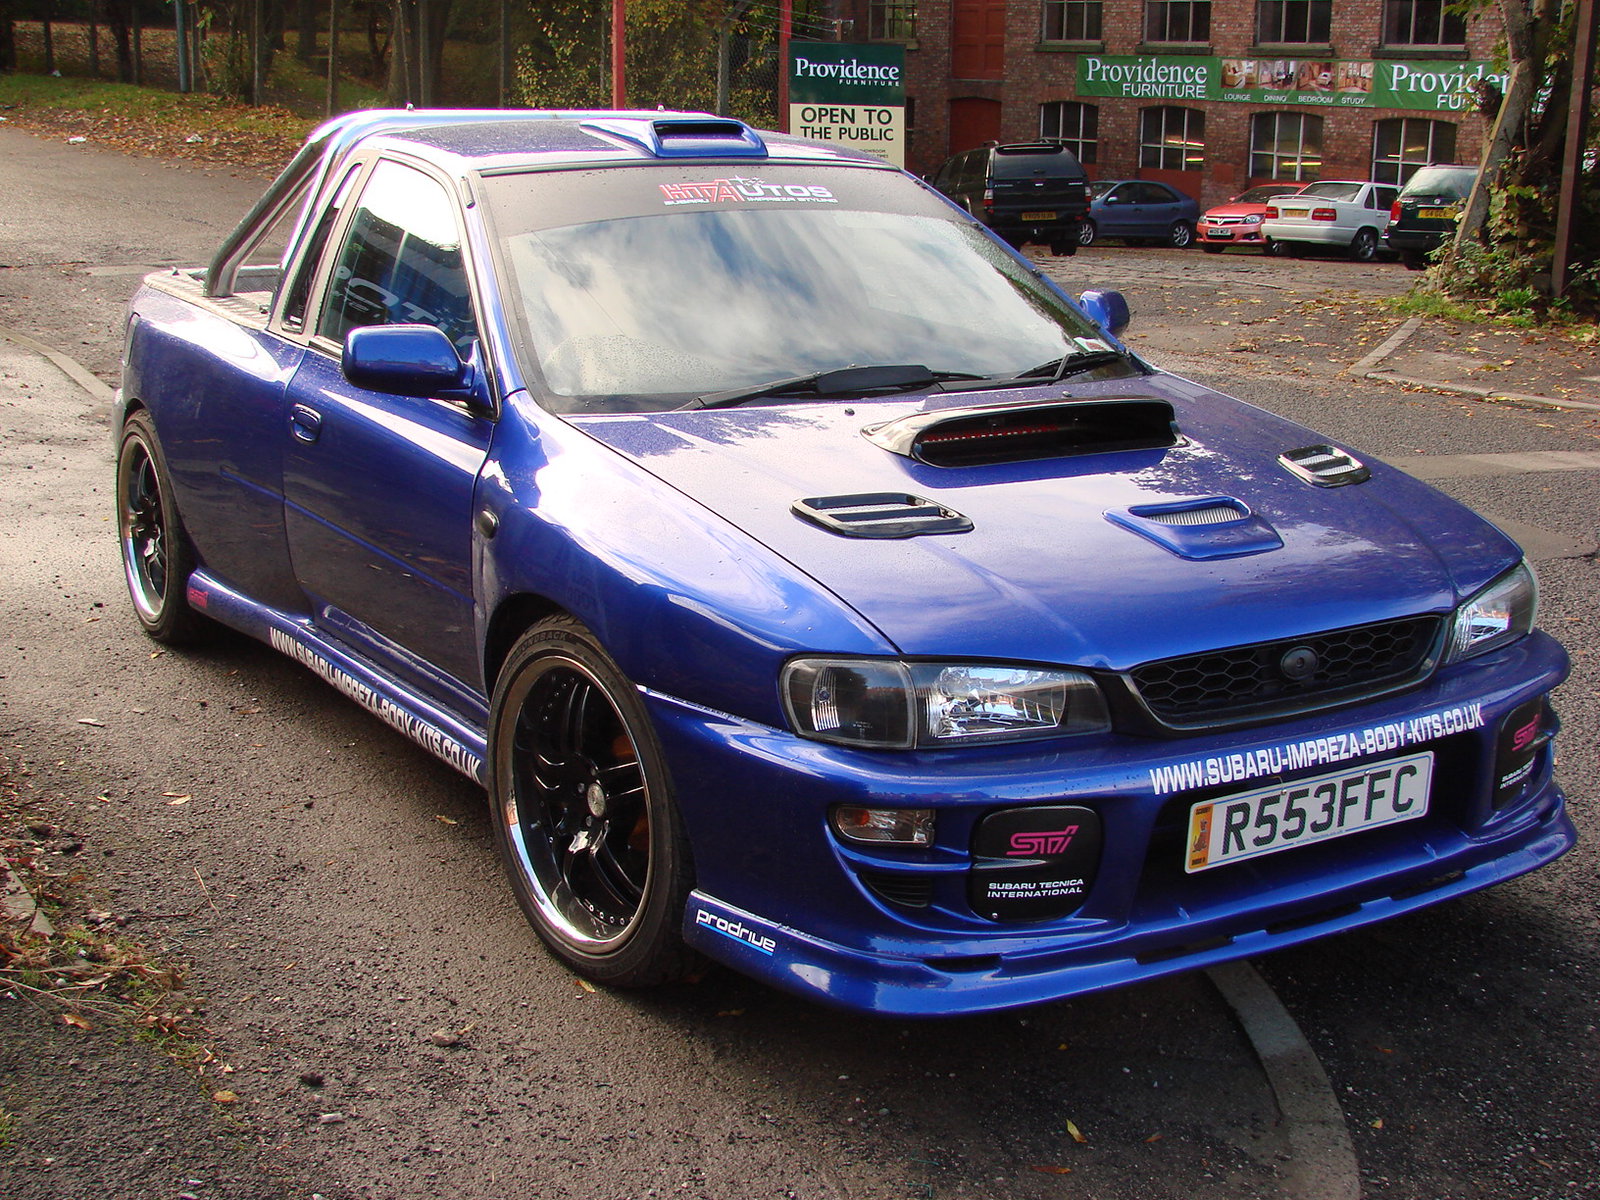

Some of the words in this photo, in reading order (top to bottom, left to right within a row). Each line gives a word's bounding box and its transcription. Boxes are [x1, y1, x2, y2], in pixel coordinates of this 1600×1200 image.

[795, 57, 900, 79] Providence
[1086, 57, 1208, 84] Providence
[839, 79, 900, 87] FURNITURE
[1122, 83, 1207, 99] FURNITURE
[1224, 93, 1251, 101] LOUNGE
[1263, 94, 1287, 102] DINING
[1298, 95, 1333, 103] BEDROOM
[1341, 96, 1366, 104] STUDY
[801, 106, 856, 124] OPEN
[863, 108, 892, 125] TO
[800, 125, 832, 139] THE
[838, 127, 894, 141] PUBLIC
[1150, 703, 1485, 796] WWW.SUBARU-IMPREZA-BODY-KITS.CO.UK
[1221, 764, 1419, 856] R553FFC
[988, 882, 1036, 890] SUBARU
[1039, 878, 1084, 889] TECNICA
[987, 886, 1082, 898] INTERNATIONAL
